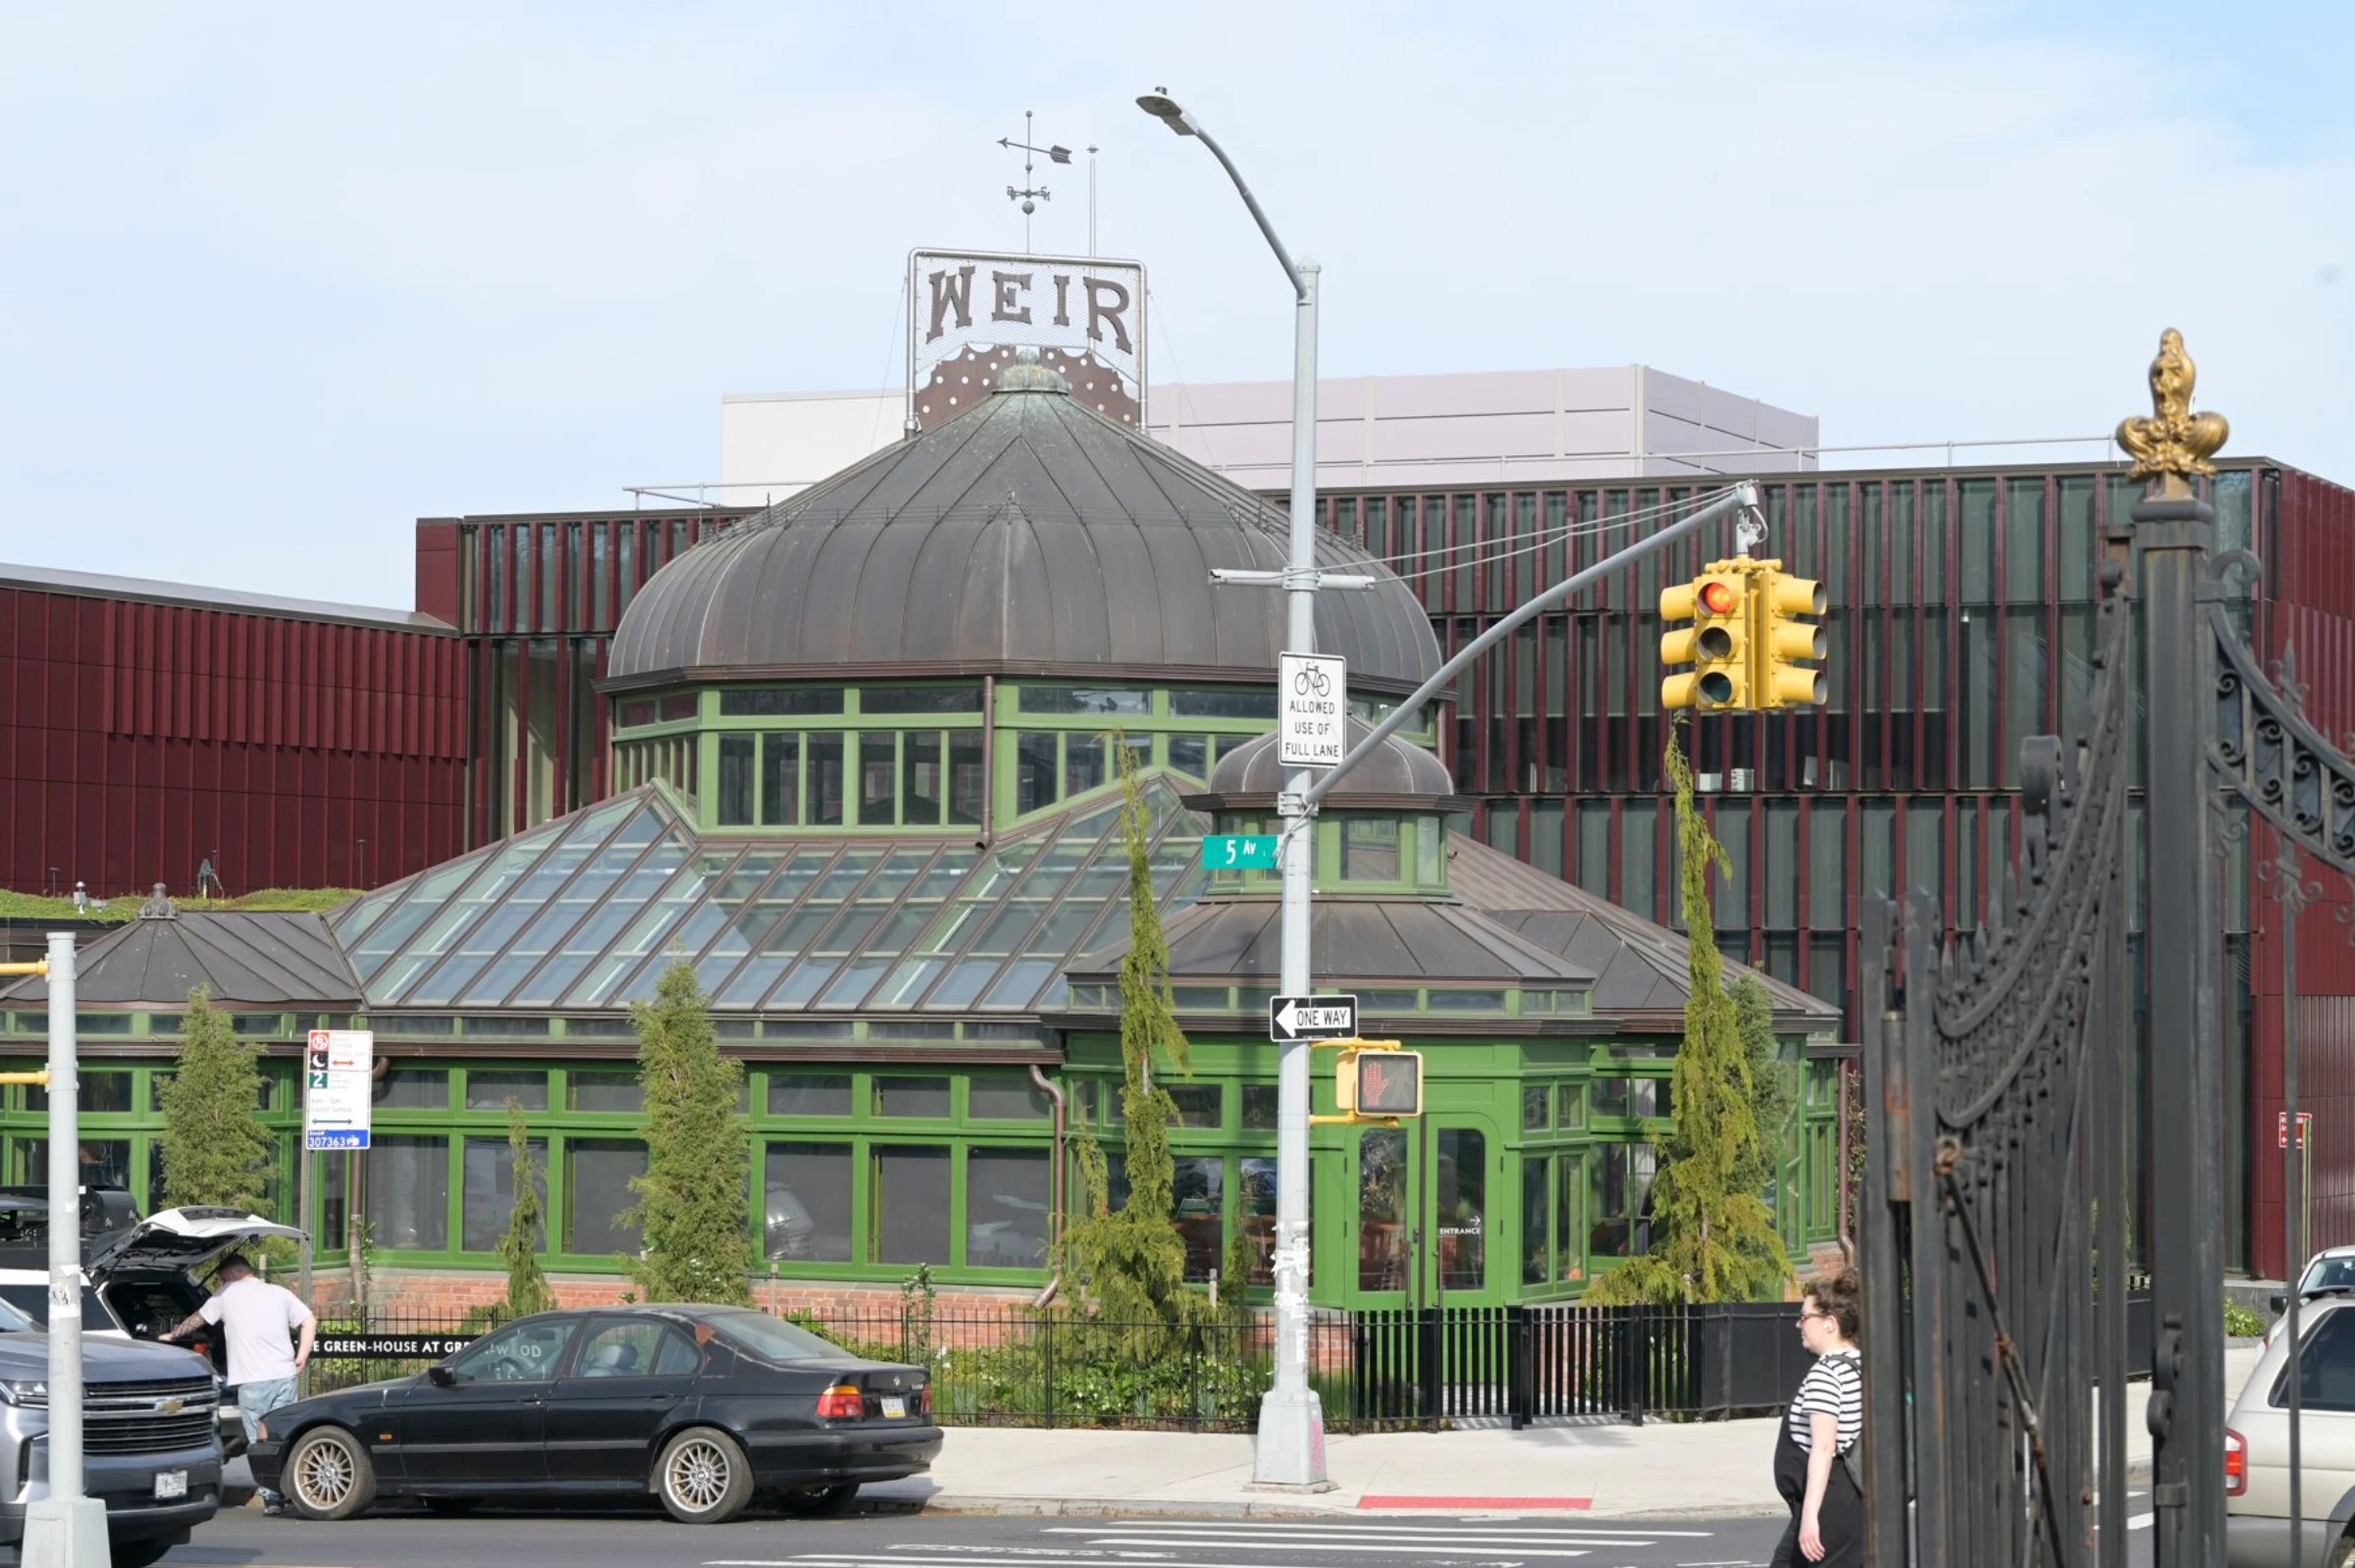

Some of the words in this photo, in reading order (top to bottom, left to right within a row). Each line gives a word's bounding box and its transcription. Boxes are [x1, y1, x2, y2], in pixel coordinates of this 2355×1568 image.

[926, 265, 1132, 354] WEIR
[1289, 700, 1335, 714] ALLOWED
[1294, 721, 1314, 735] USE
[1317, 723, 1331, 735] OF
[1285, 742, 1310, 756] FULL
[1313, 745, 1339, 758] LANE
[1226, 839, 1236, 864] 5
[1296, 1010, 1320, 1026] ONE
[1324, 1010, 1347, 1026] WAY
[313, 1071, 324, 1088] 2
[309, 1136, 345, 1147] 307363
[324, 1340, 418, 1353] GREEN-HOUSE
[421, 1340, 440, 1353] AT
